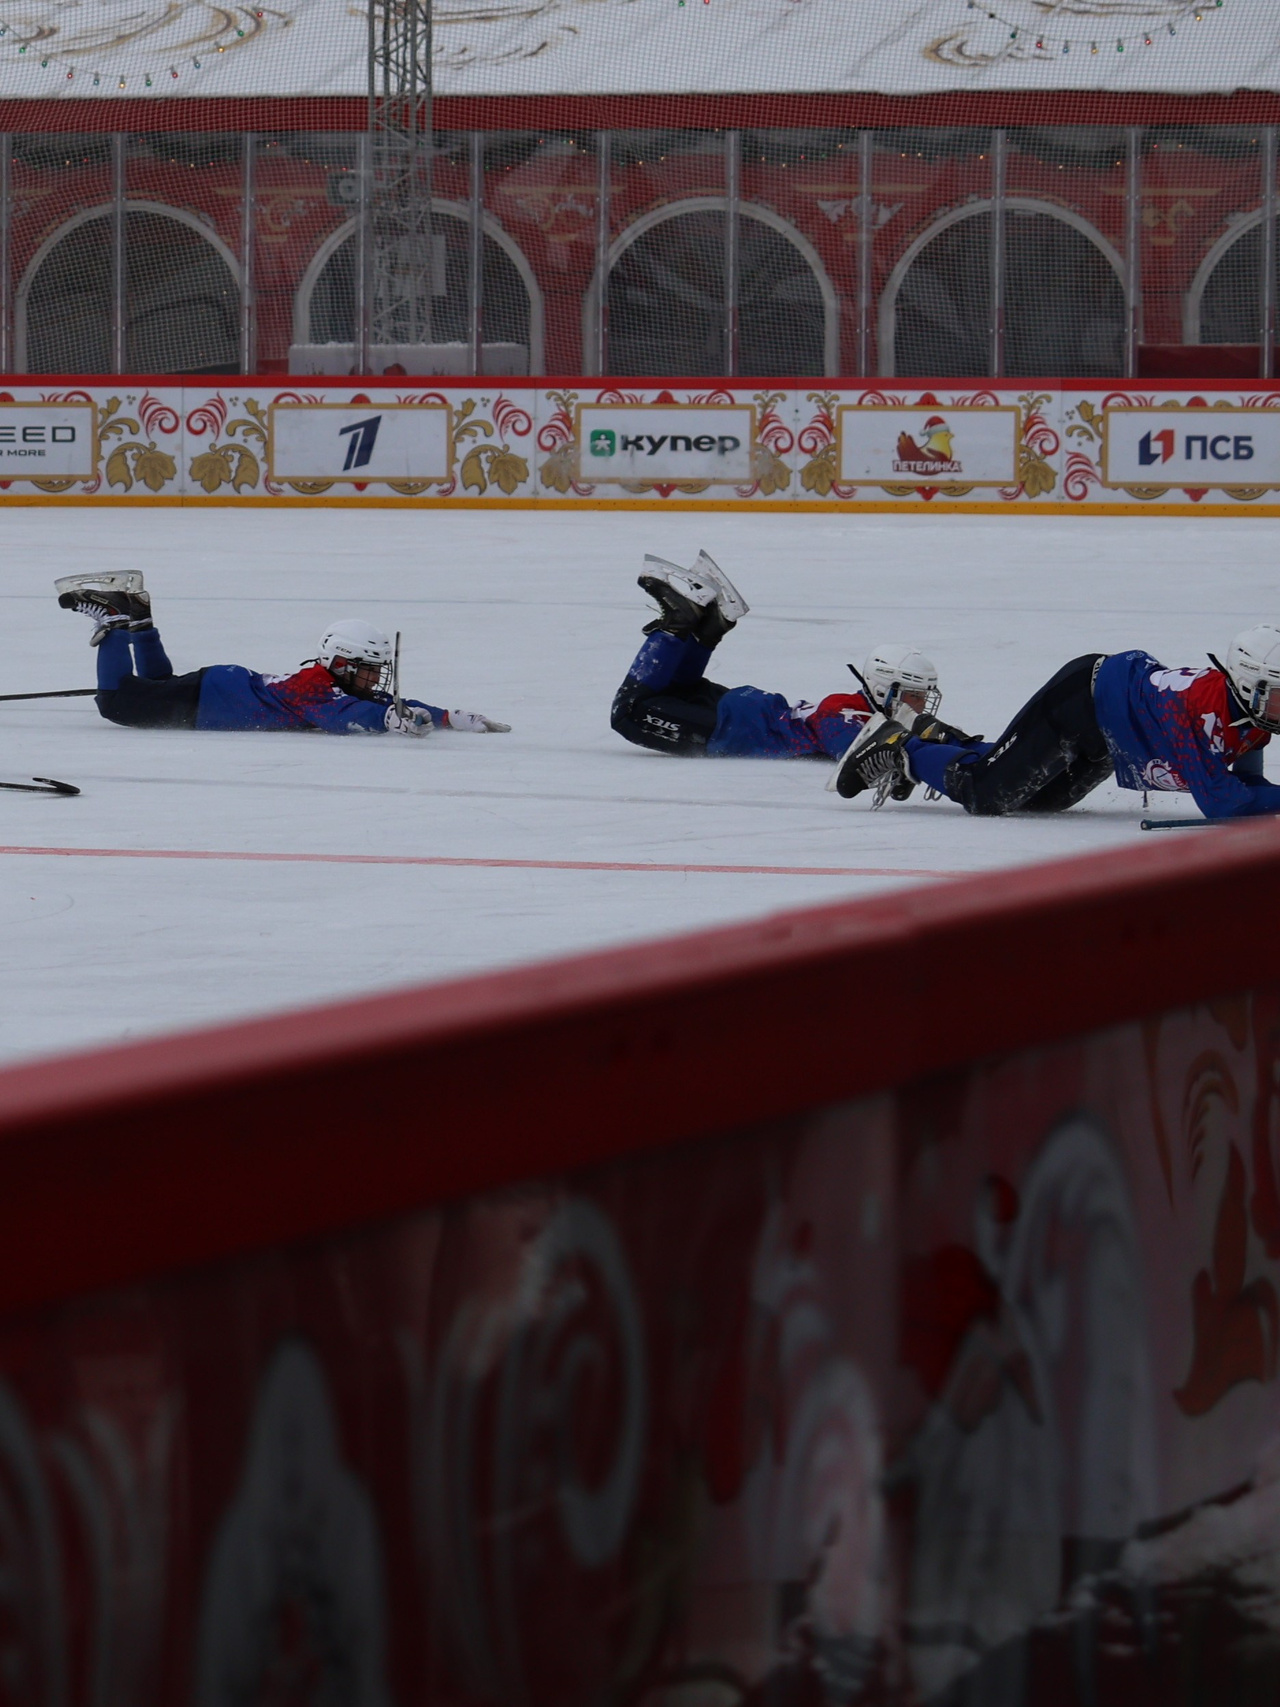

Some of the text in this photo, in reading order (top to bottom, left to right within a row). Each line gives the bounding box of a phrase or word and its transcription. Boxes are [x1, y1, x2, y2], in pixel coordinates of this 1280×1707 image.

[7, 449, 46, 457] MORE
[621, 434, 740, 456] купер
[1185, 435, 1254, 460] ПСБ
[893, 460, 961, 472] ПЕТЕЛИНКА
[642, 714, 681, 731] STEX
[986, 732, 1018, 767] STEX
